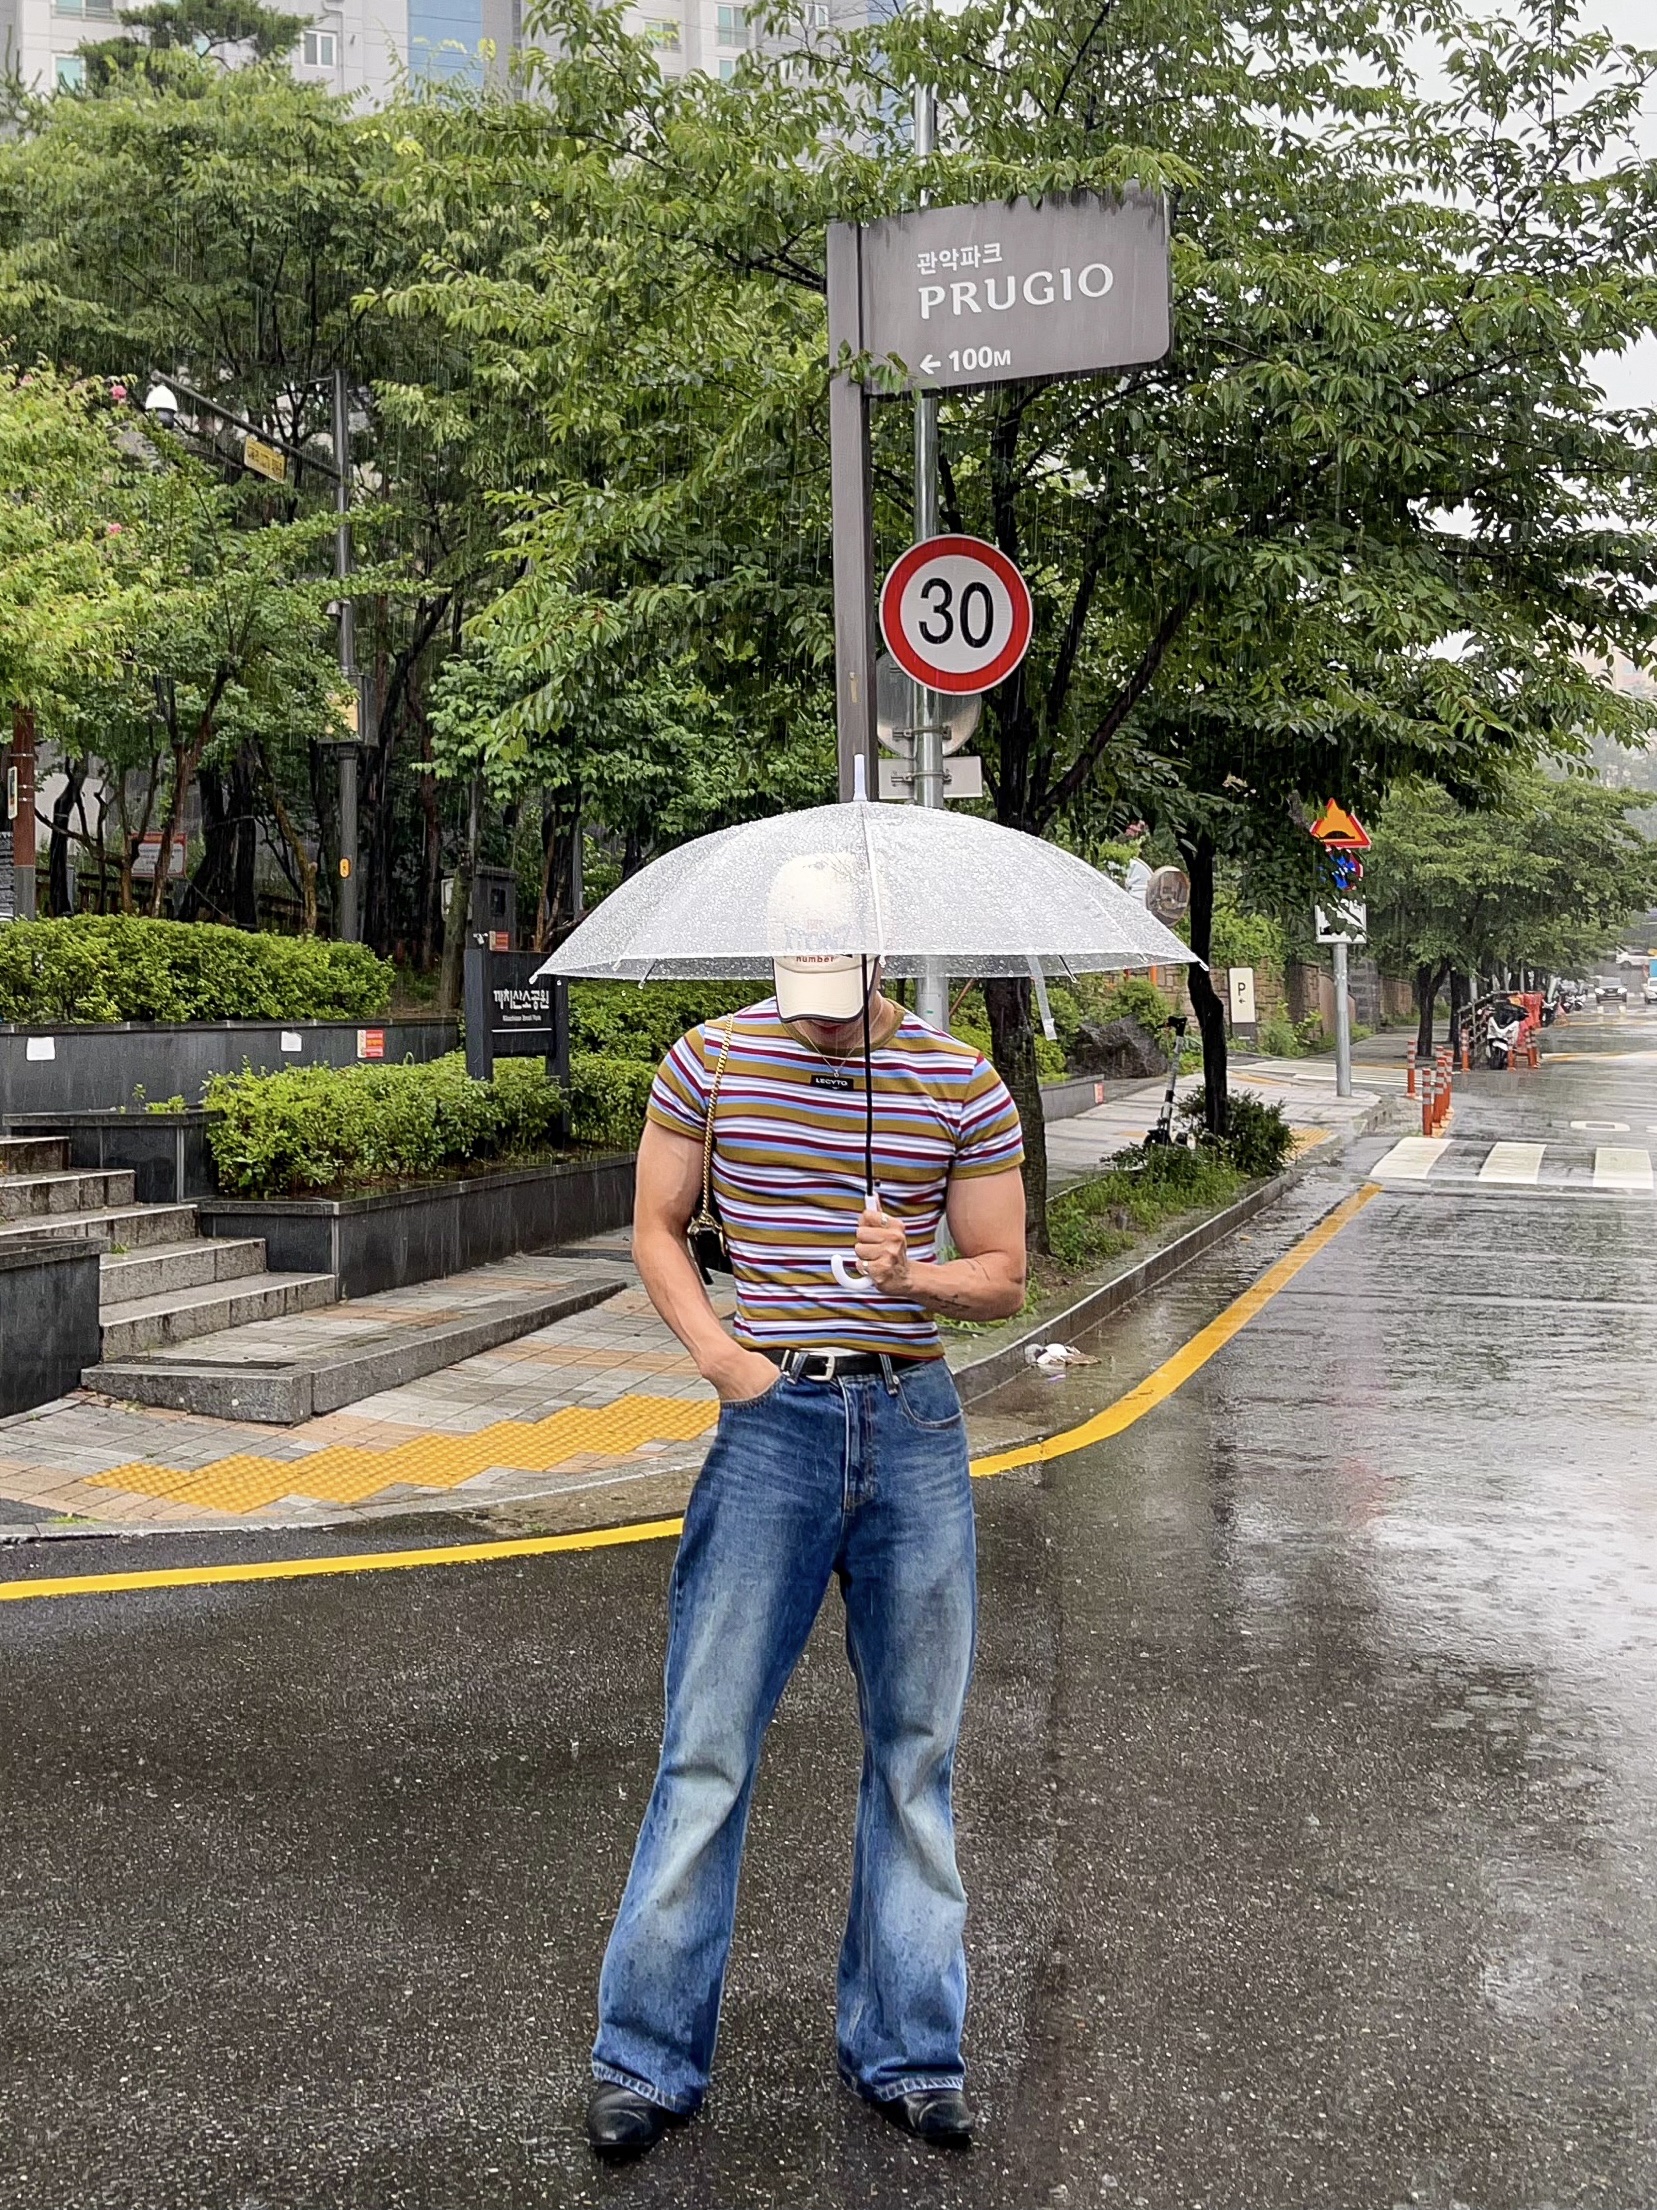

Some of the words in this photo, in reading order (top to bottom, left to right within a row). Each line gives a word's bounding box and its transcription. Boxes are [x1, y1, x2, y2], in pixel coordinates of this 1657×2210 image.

[916, 242, 1004, 276] 관악파크
[917, 263, 1115, 320] PRUGIO
[948, 346, 1012, 373] 100M
[918, 577, 994, 649] 30
[1238, 982, 1246, 996] P
